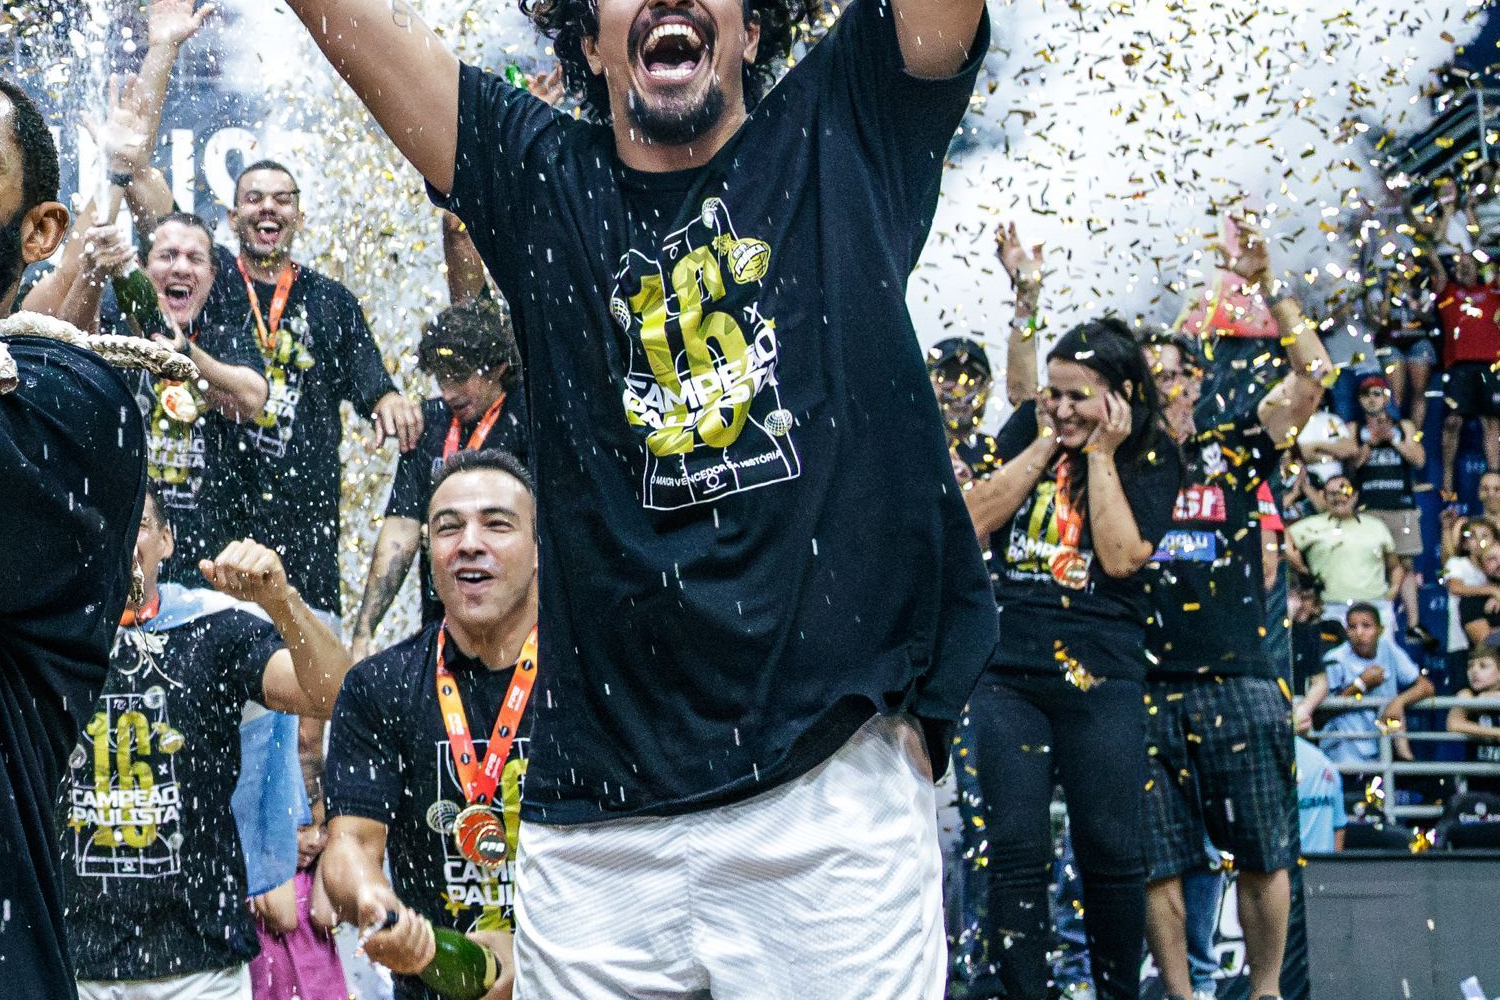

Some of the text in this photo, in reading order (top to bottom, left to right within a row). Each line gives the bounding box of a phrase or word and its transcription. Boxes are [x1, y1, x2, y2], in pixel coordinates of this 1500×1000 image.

[87, 711, 157, 848] 16
[72, 783, 180, 808] CAMPEÃO
[73, 806, 181, 826] PAULISTA
